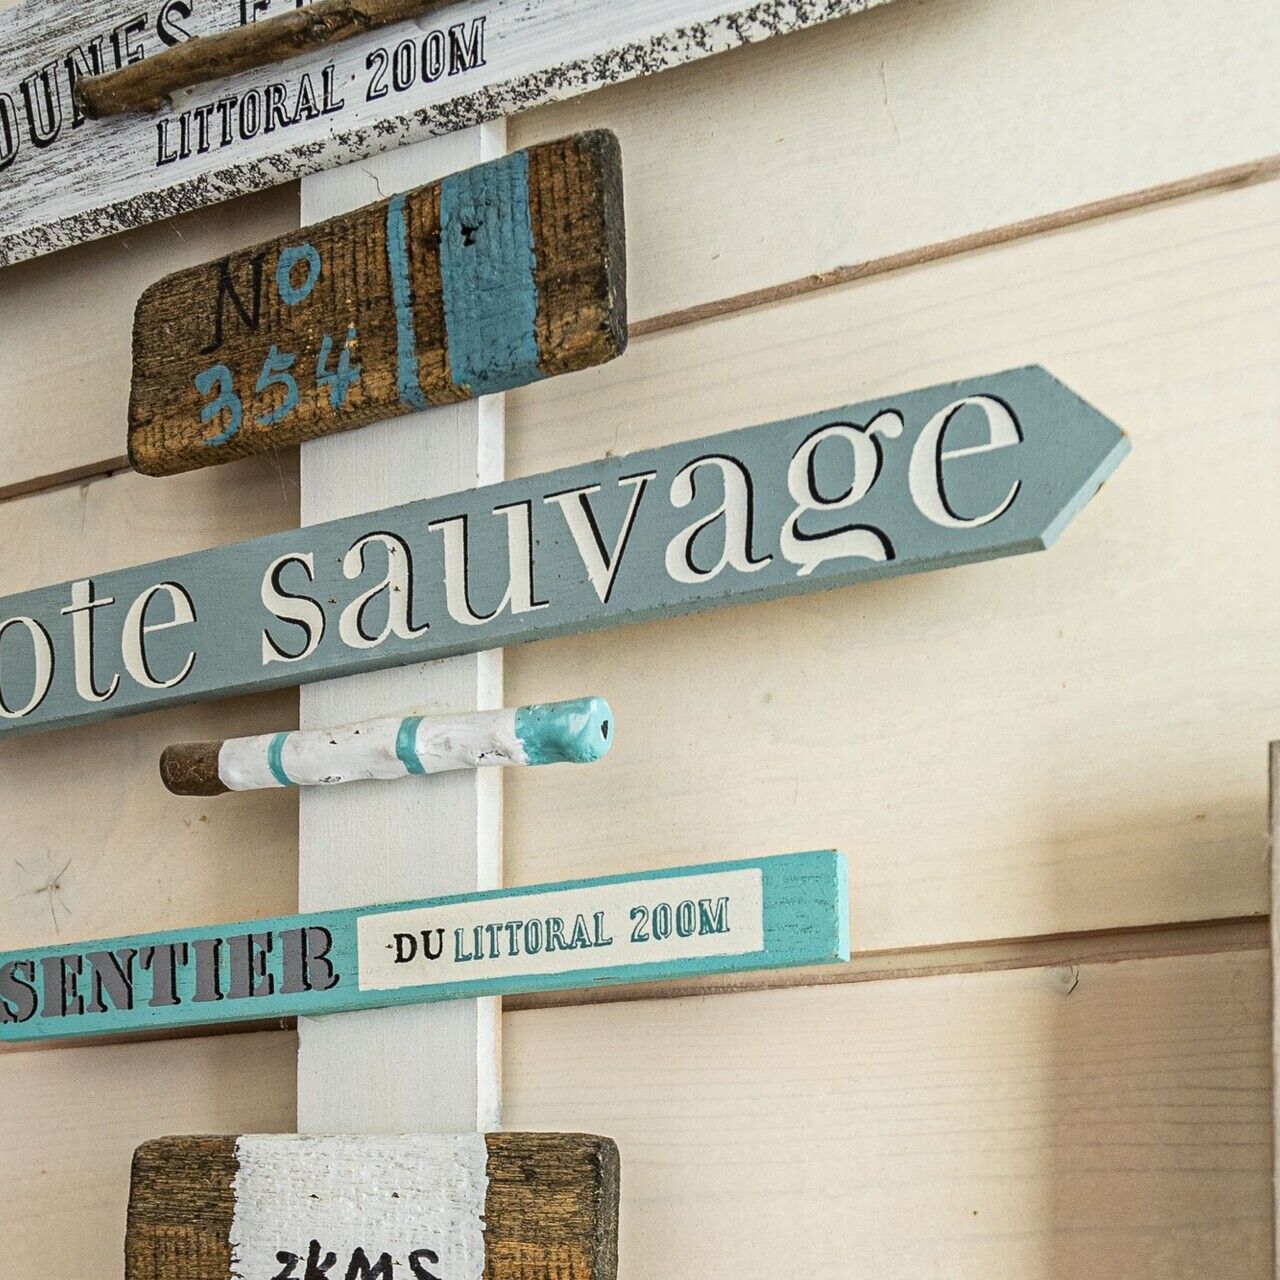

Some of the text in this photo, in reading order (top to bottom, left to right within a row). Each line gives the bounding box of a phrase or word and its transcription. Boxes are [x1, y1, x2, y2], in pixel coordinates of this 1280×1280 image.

[156, 16, 487, 166] LITTORAL 200M
[194, 327, 361, 447] 354
[260, 394, 1024, 668] sauvage
[394, 928, 445, 963] DU
[452, 911, 613, 963] LITTORAL
[629, 897, 730, 943] 200M
